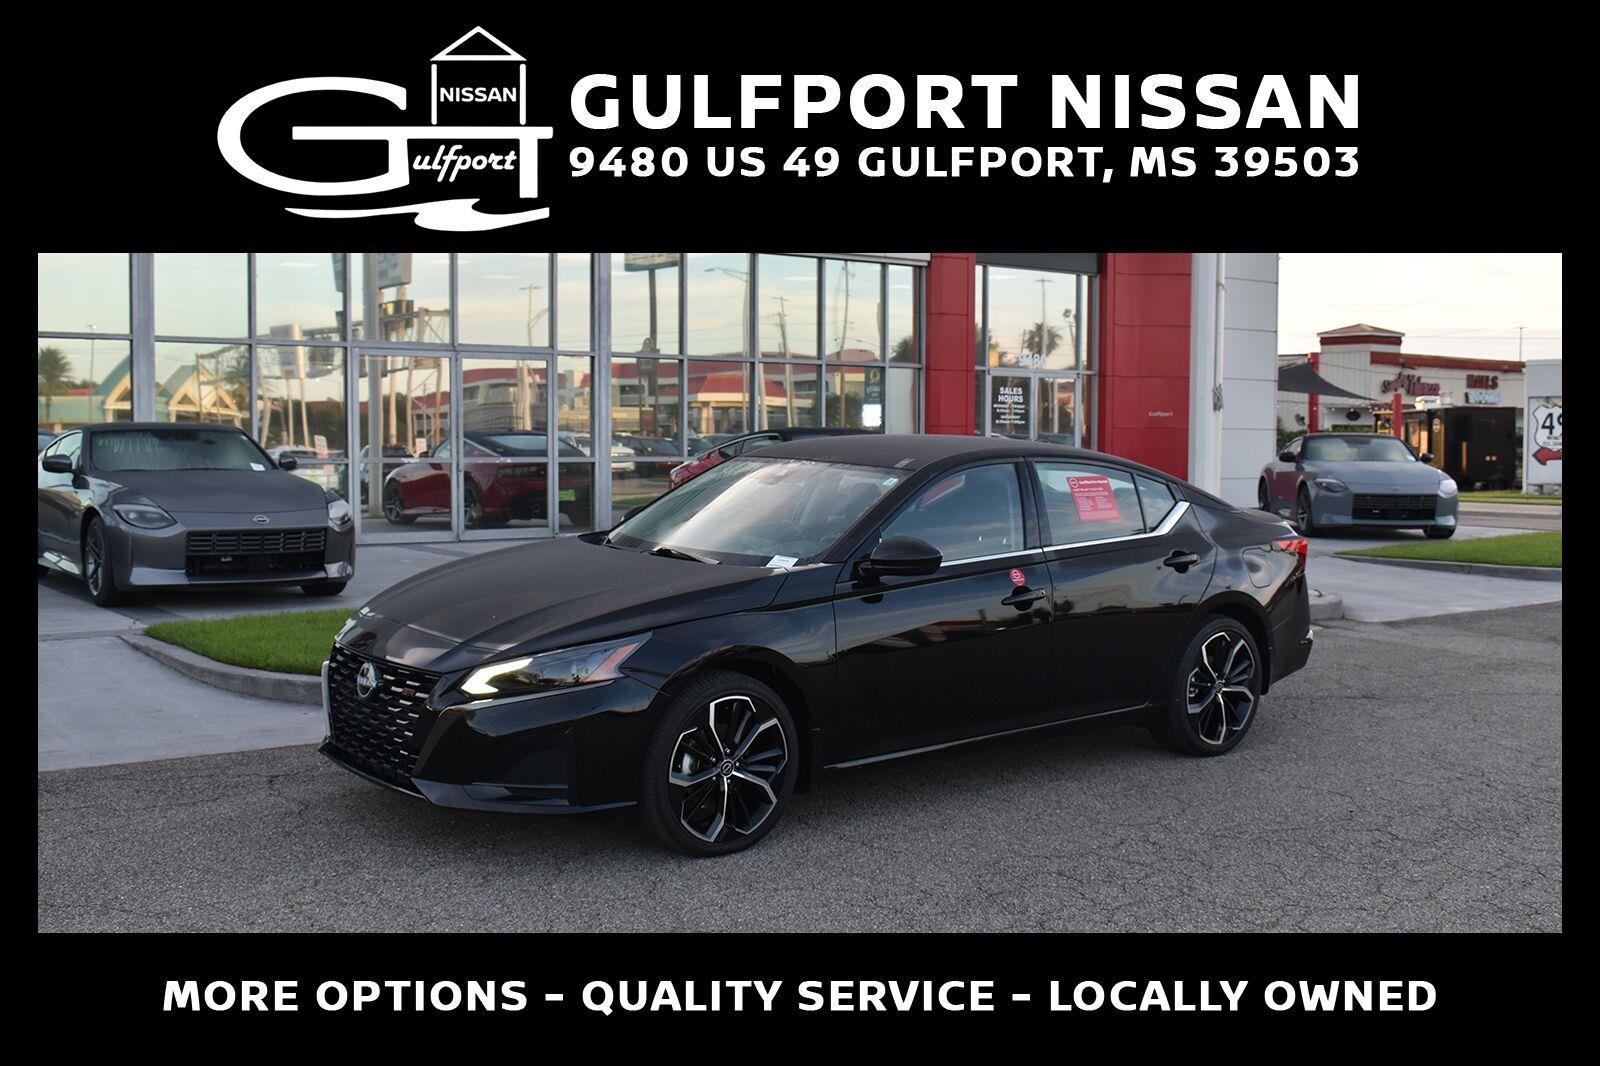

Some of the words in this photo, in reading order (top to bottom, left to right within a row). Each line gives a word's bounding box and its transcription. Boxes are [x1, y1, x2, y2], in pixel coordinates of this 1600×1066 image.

[1019, 353, 1048, 369] 9480
[999, 387, 1023, 395] SALES
[998, 395, 1024, 403] HOURS
